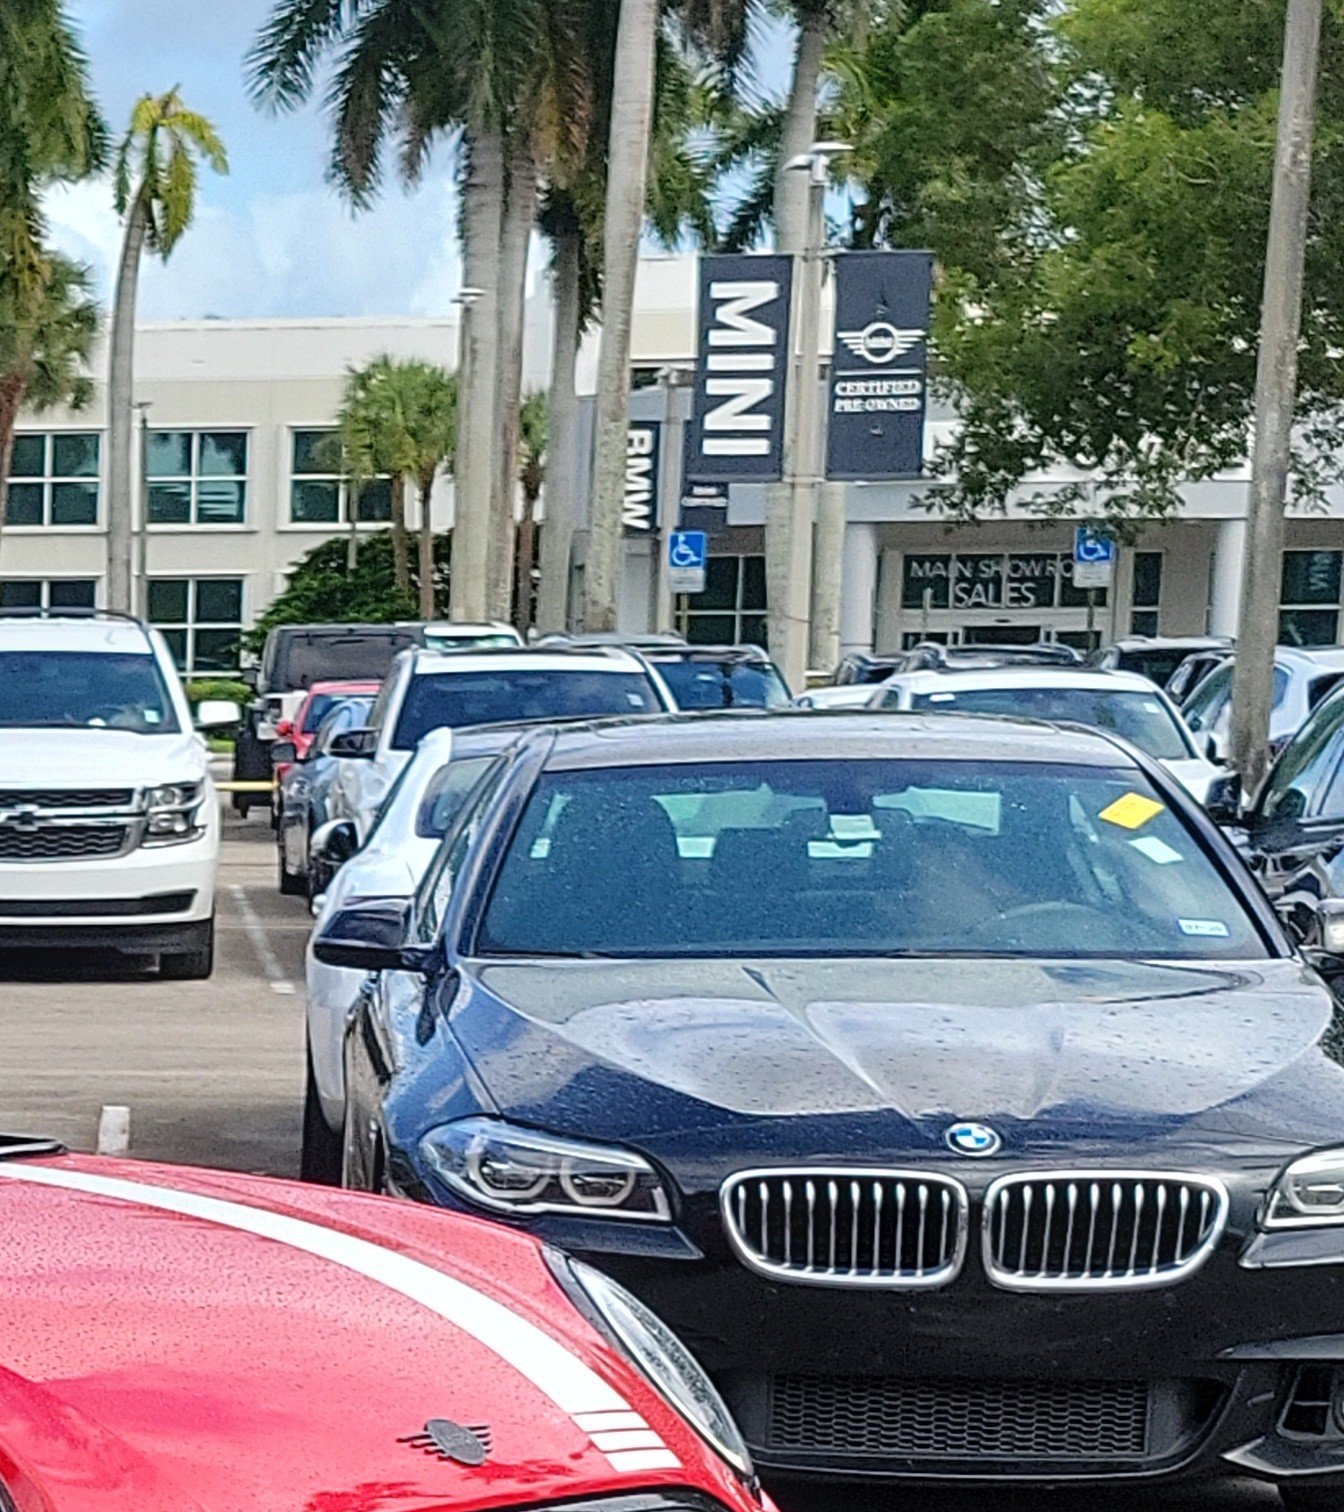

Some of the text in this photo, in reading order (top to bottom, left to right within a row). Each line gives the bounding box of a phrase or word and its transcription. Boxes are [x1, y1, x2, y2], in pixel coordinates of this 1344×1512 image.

[702, 281, 779, 455] MINI
[621, 429, 653, 529] BMW
[955, 582, 1035, 607] SALES
